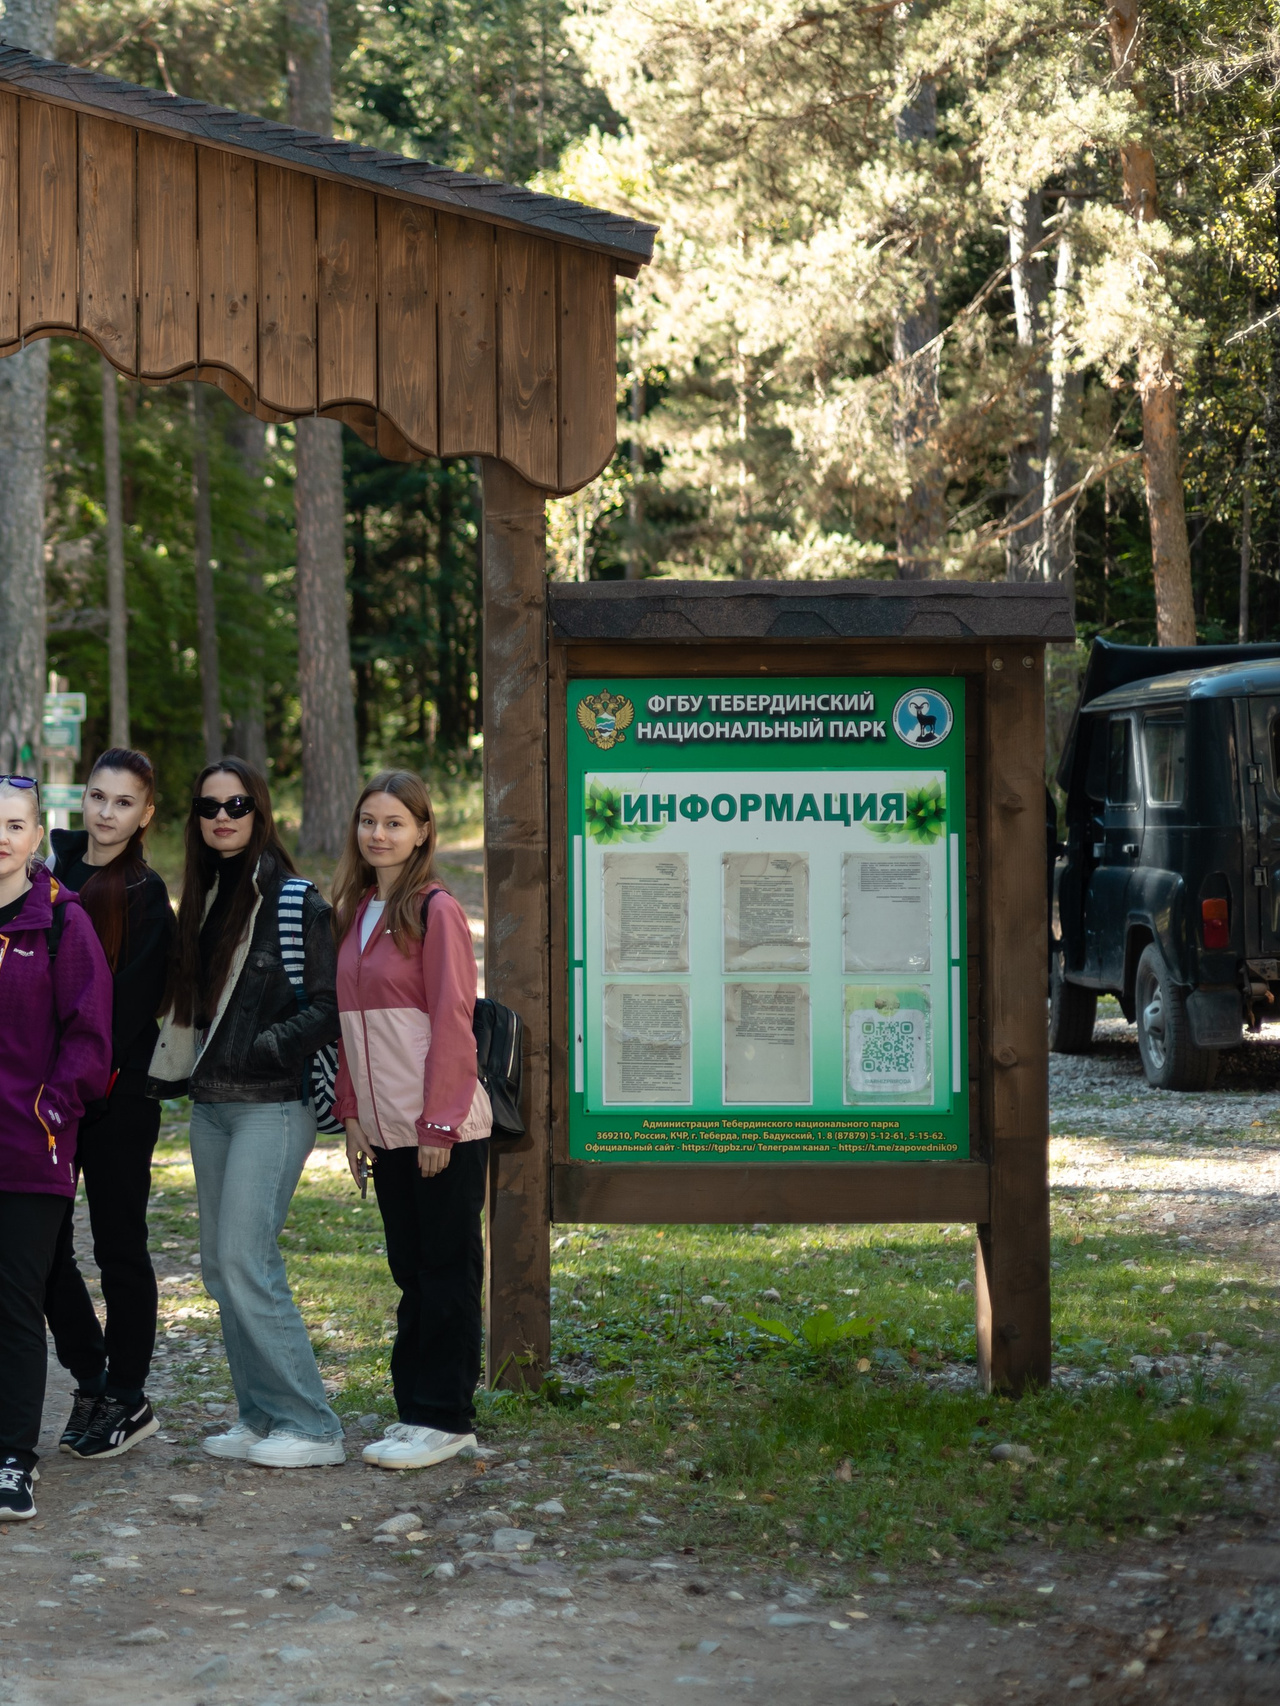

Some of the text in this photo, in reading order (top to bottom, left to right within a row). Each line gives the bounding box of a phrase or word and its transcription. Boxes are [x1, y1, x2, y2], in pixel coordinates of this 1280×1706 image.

[648, 691, 875, 715] ФГБУ ТЕБЕРДИНСКИЙ
[636, 718, 886, 742] НАЦИОНАЛЬНЫЙ ПАРК
[623, 792, 906, 827] ИНФОРМАЦИЯ
[643, 1119, 720, 1130] Администрация
[722, 1119, 793, 1130] Тебердинского
[871, 1122, 899, 1130] парка
[597, 1131, 632, 1142] 369210,
[634, 1131, 668, 1142] Россия,
[670, 1131, 689, 1142] КЧР,
[700, 1131, 740, 1142] Теберда,
[741, 1133, 761, 1142] пер.
[763, 1131, 815, 1142] Бадукский,
[834, 1131, 868, 1142] (87879)
[871, 1131, 907, 1142] 5-12-61,
[909, 1131, 946, 1140] 5-15-62.
[585, 1143, 652, 1153] Официальный
[654, 1143, 674, 1151] сайт
[682, 1143, 755, 1153] https://tgpbz.ru/
[758, 1143, 800, 1153] Телеграм
[838, 1143, 957, 1153] https://t.me/zapovednik09
